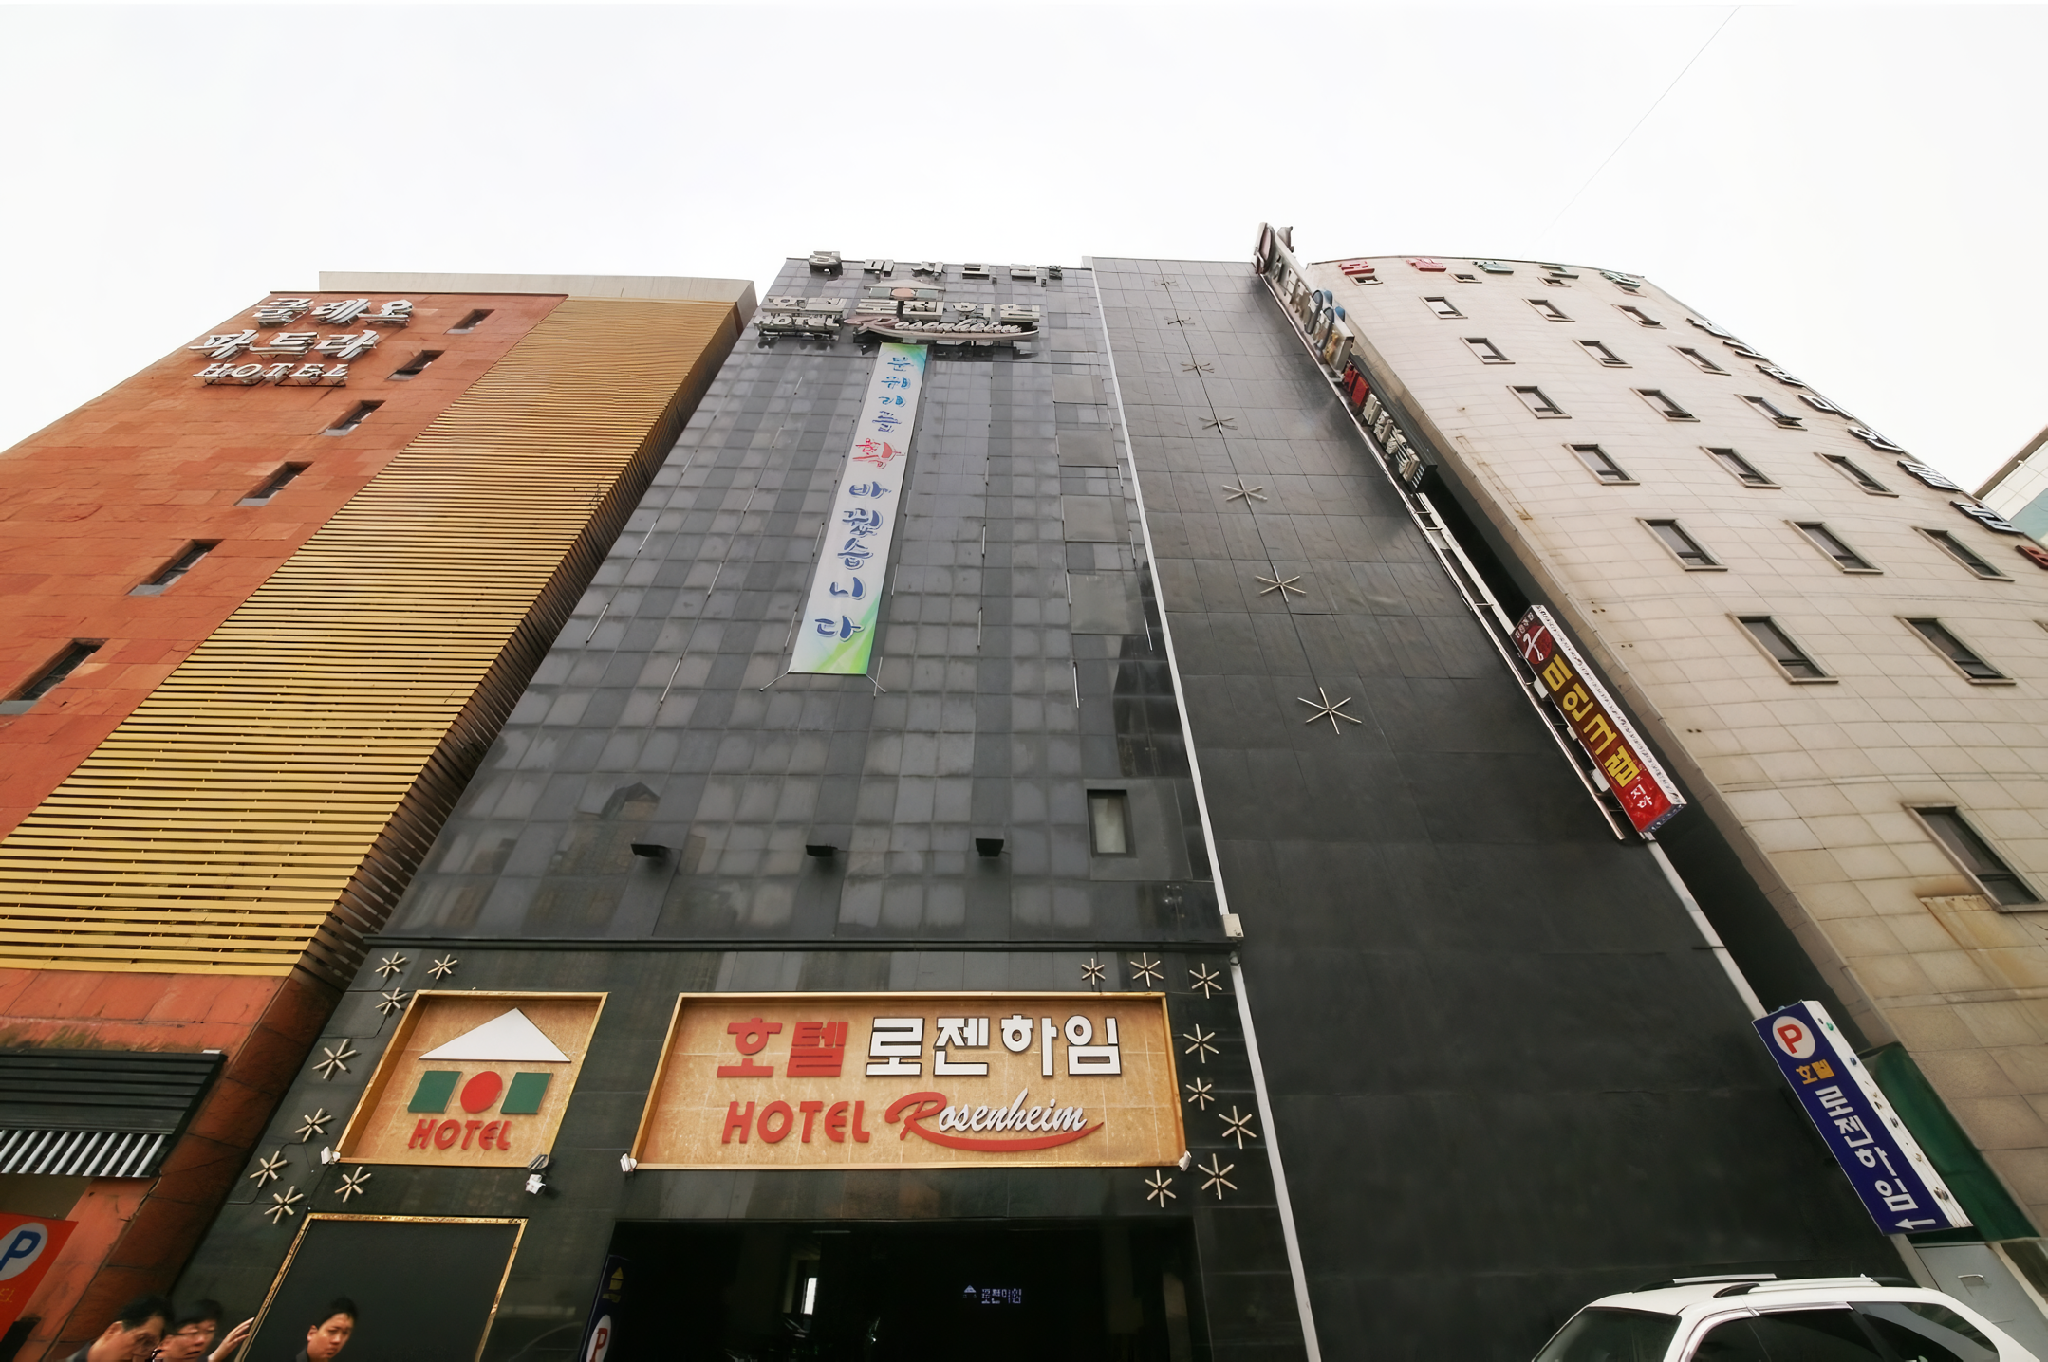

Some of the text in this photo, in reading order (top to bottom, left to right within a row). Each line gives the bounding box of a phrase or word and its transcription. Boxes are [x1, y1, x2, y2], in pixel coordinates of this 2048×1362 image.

[193, 362, 348, 381] HOTEL
[717, 1014, 1122, 1078] 호텔 로젠하임
[1777, 1023, 1803, 1054] P
[407, 1118, 513, 1150] HOTEL
[721, 1088, 1104, 1152] HOTEL Rosenheim
[1814, 1085, 1919, 1212] 로젠하임
[0, 1230, 42, 1273] P
